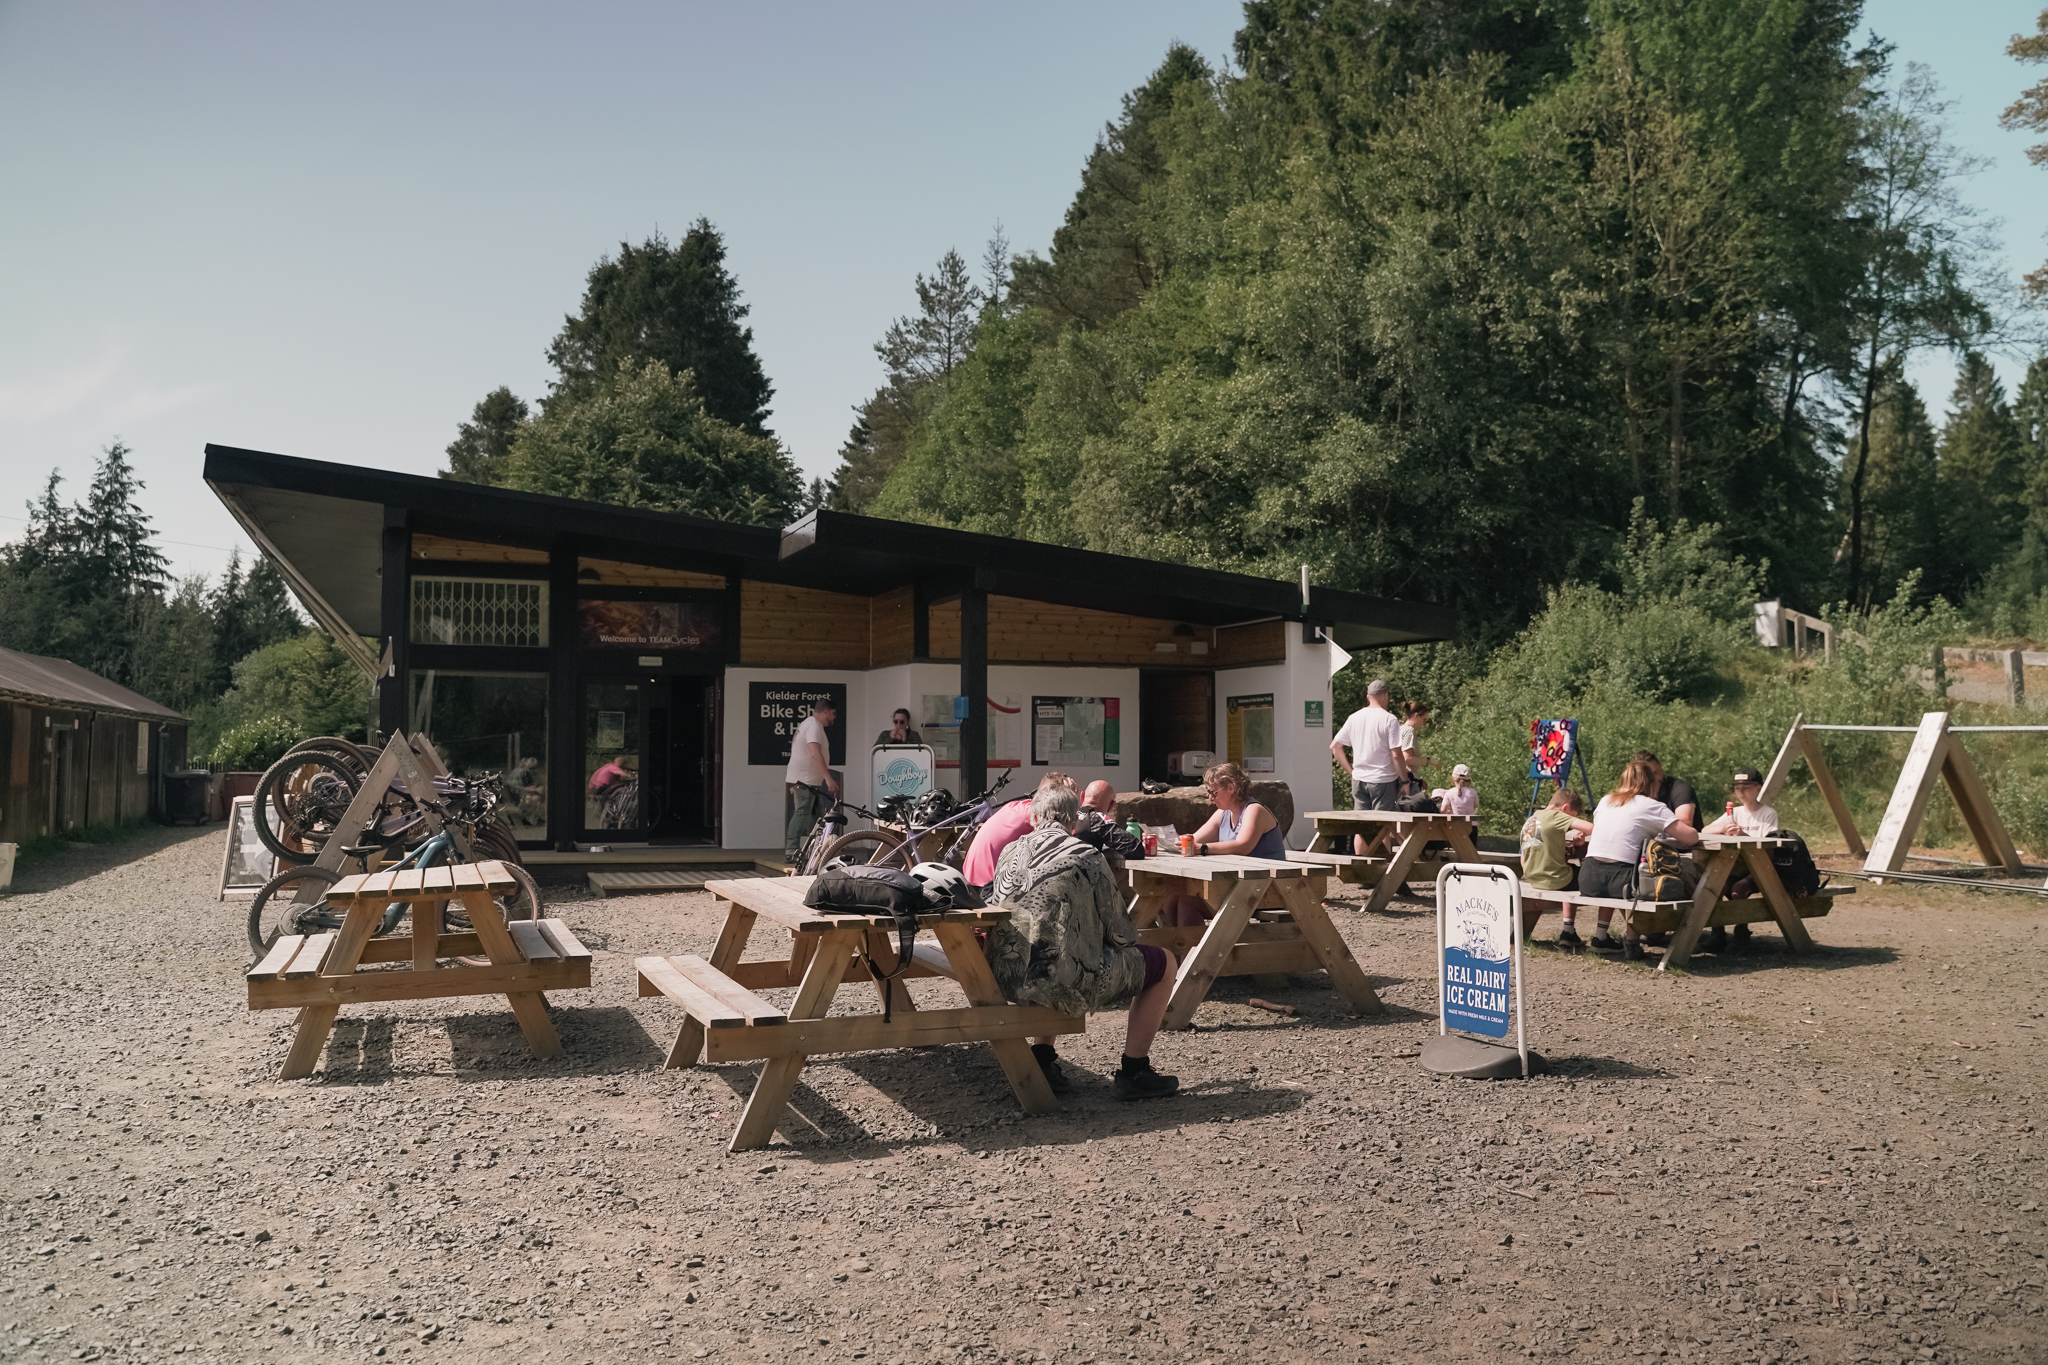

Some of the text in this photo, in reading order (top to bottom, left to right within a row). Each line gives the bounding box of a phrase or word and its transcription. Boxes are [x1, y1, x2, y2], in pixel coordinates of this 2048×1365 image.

[600, 635, 636, 643] Welcome
[766, 691, 831, 701] Kielder Forest
[760, 703, 815, 718] Bike Sh
[774, 721, 786, 735] &
[877, 767, 927, 788] Doughboys
[1455, 897, 1499, 921] MACKIE'S
[1447, 964, 1507, 990] REAL DAIRY
[1446, 984, 1507, 1013] ICE CREAM
